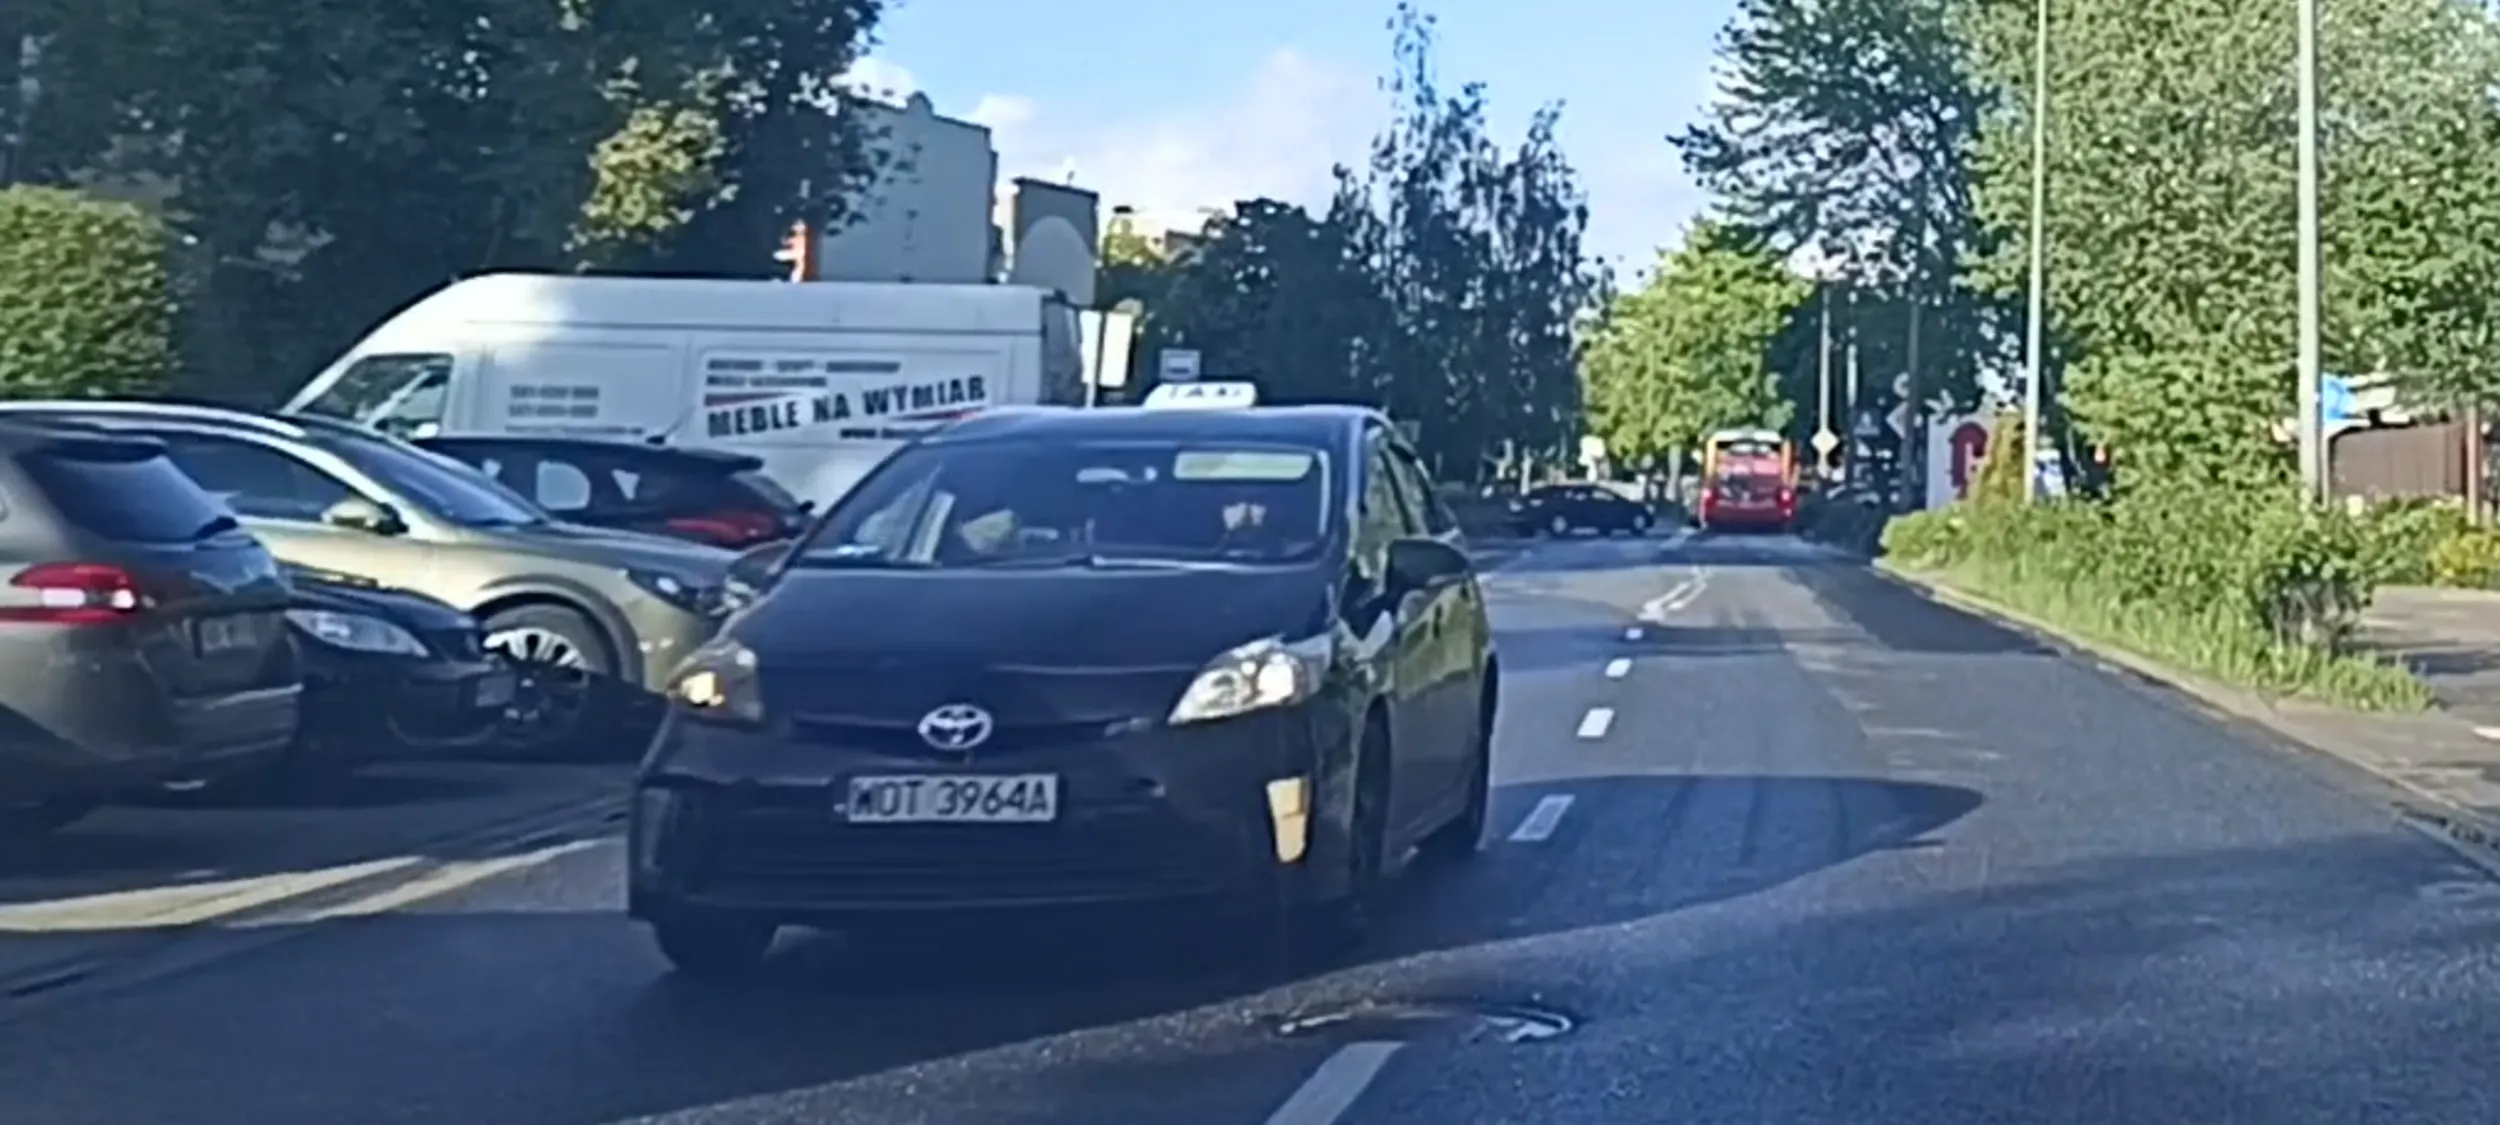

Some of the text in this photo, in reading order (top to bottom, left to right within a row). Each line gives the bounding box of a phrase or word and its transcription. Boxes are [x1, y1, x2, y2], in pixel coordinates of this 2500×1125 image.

[707, 375, 985, 437] MEBLE NA WYMIAR
[935, 780, 1050, 817] 3964A
